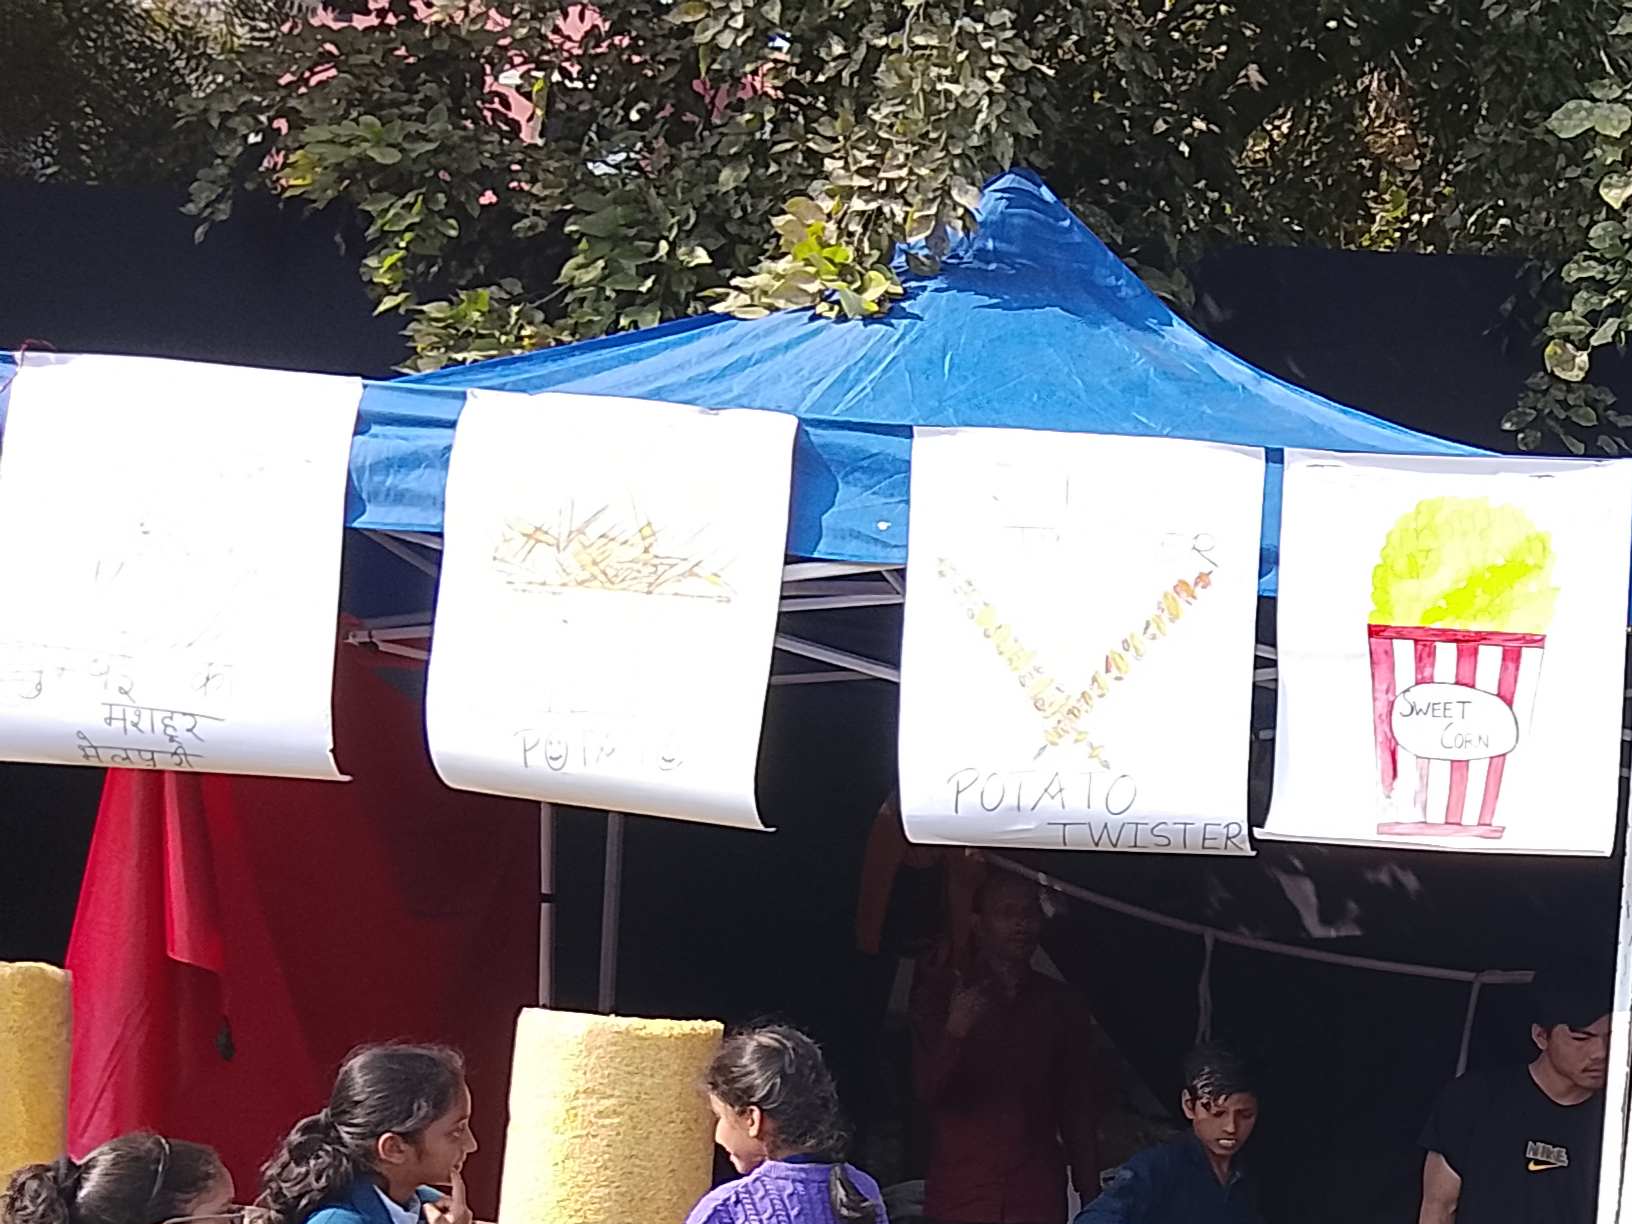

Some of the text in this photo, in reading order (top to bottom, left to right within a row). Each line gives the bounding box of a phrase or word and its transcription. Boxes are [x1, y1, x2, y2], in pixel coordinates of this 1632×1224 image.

[1400, 688, 1472, 719] SWEET
[513, 728, 684, 772] POTAO
[1440, 722, 1489, 749] CORN
[947, 767, 1137, 815] POTATO
[1046, 821, 1244, 850] TWISTER
[1525, 1140, 1569, 1166] NIKE
